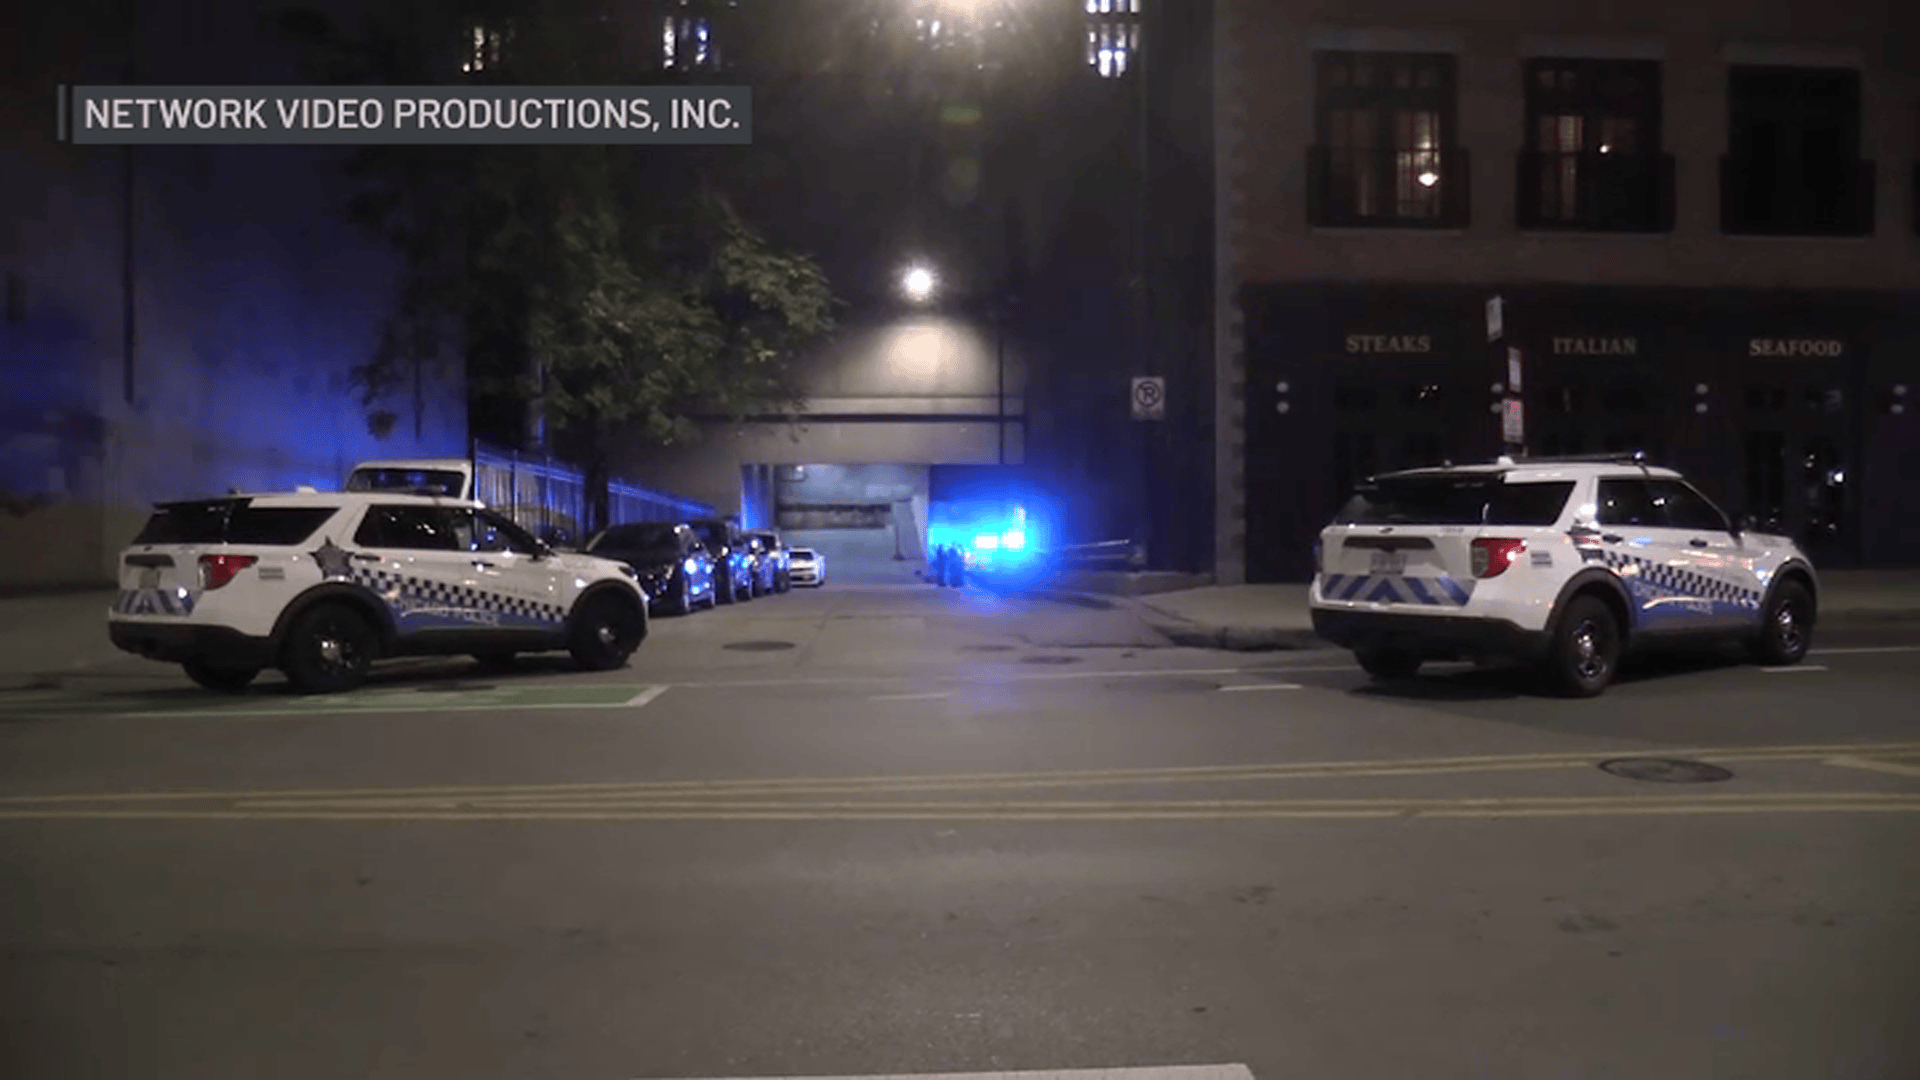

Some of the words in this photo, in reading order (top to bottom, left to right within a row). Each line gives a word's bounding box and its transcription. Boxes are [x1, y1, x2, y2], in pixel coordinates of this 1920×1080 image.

[1346, 334, 1431, 353] STEAKS
[1553, 337, 1637, 355] ITALIAN
[1749, 339, 1842, 356] SEAFOOD
